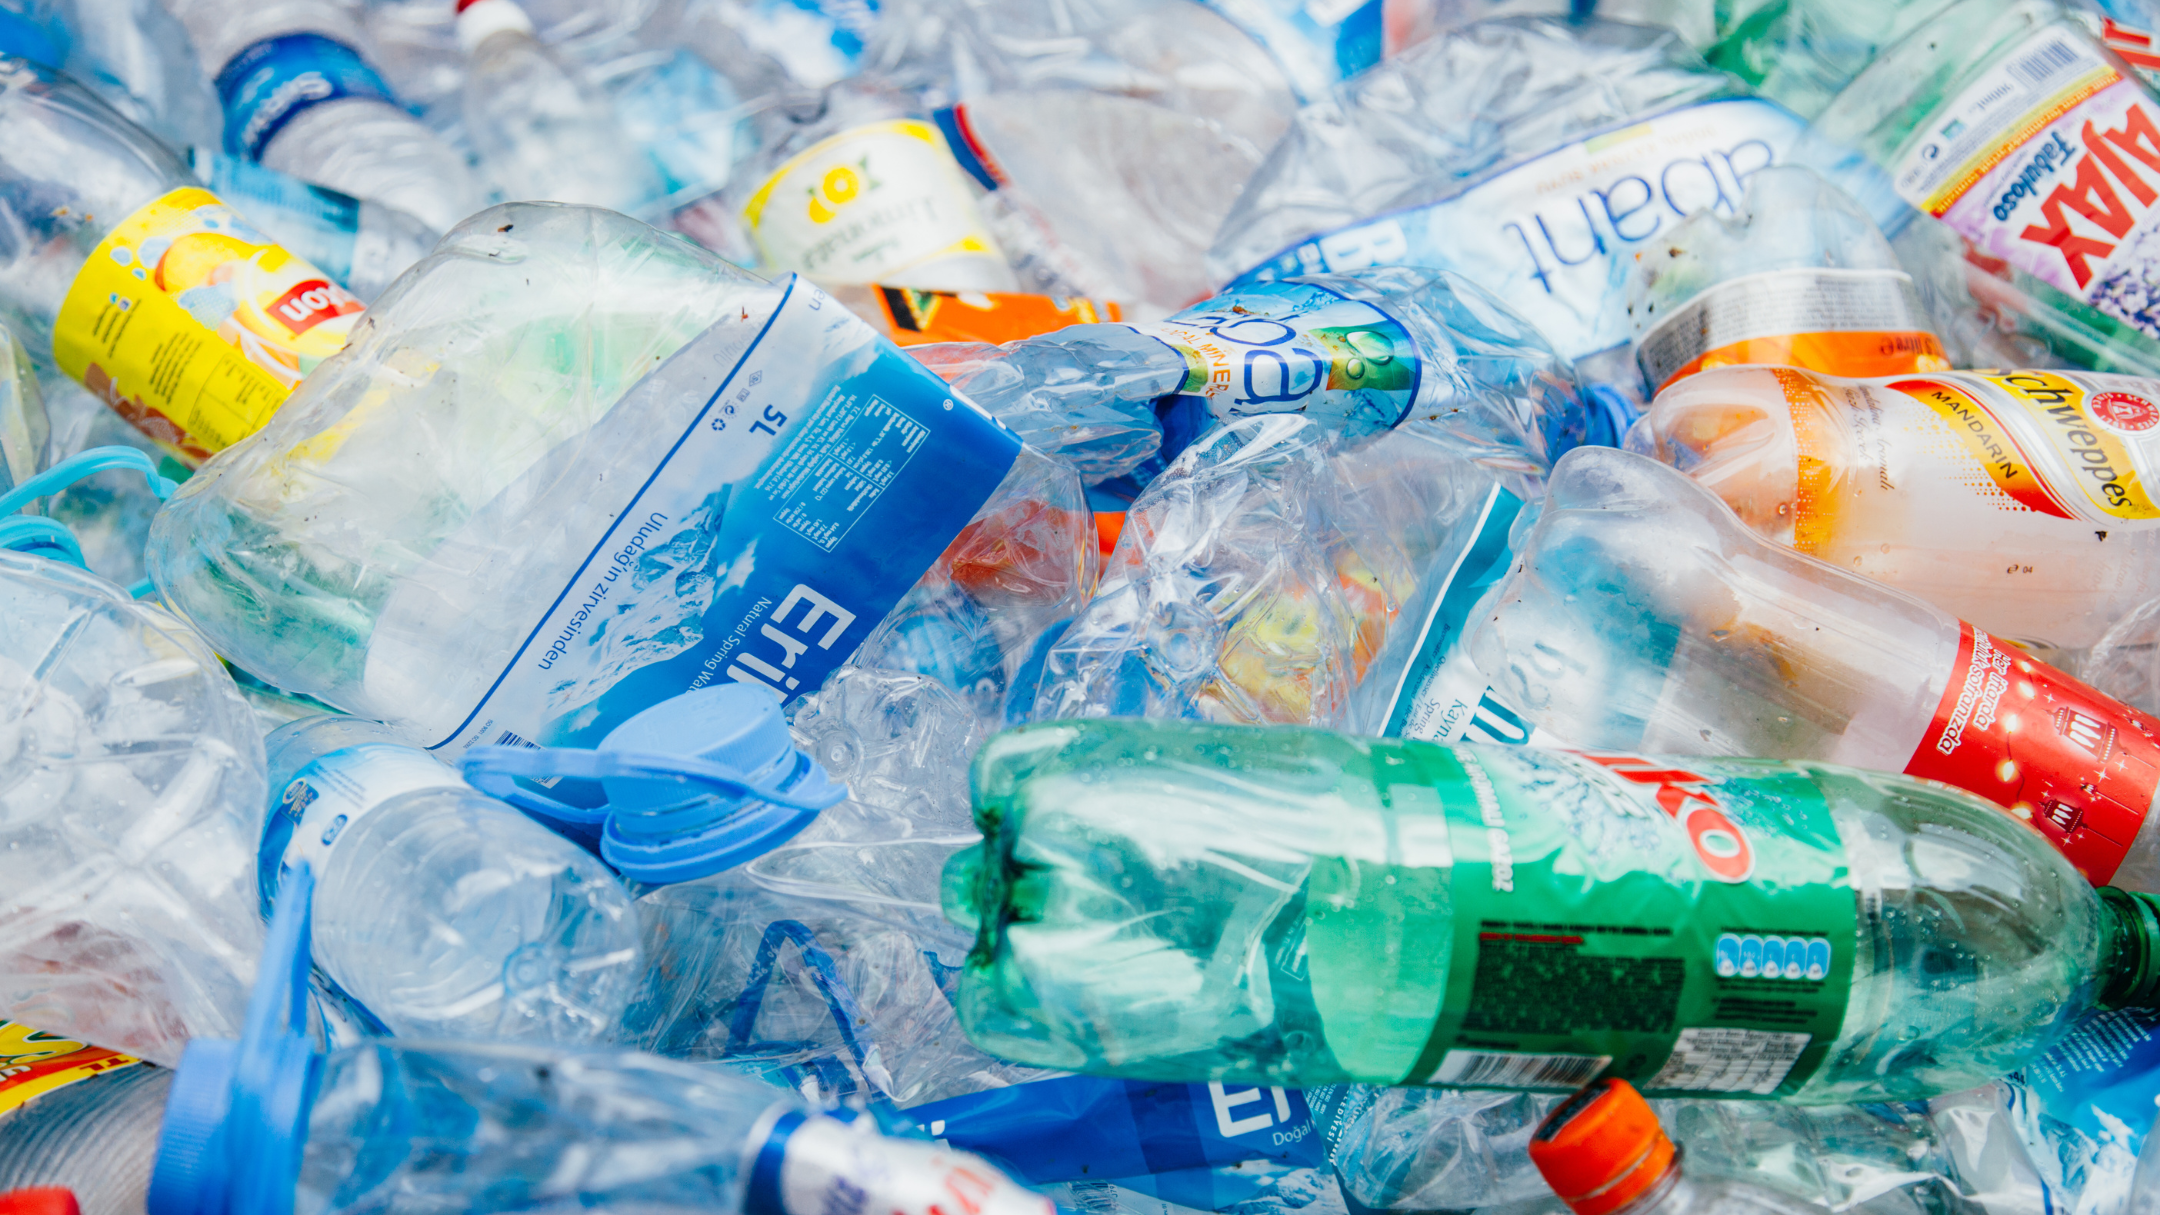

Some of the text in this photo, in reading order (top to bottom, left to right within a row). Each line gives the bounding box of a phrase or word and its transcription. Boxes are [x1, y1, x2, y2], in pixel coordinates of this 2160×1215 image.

[1502, 139, 1776, 294] abant
[1993, 131, 2076, 221] Fabuloso
[2019, 103, 2160, 291] AJAX
[746, 402, 788, 446] 5L
[1931, 391, 2018, 480] MANDARIN
[2003, 372, 2133, 512] chweppes
[537, 511, 668, 671] Uludağ'ın zirvesinden
[732, 593, 773, 639] Natural
[702, 630, 741, 673] Spring
[1406, 662, 1432, 700] Kildevand
[1419, 654, 1448, 699] Quellwasser
[1971, 648, 2012, 732] Her iftarda
[1410, 695, 1441, 736] Spring
[1936, 666, 1987, 755] sofranızda
[1271, 1118, 1311, 1146] Doğal
